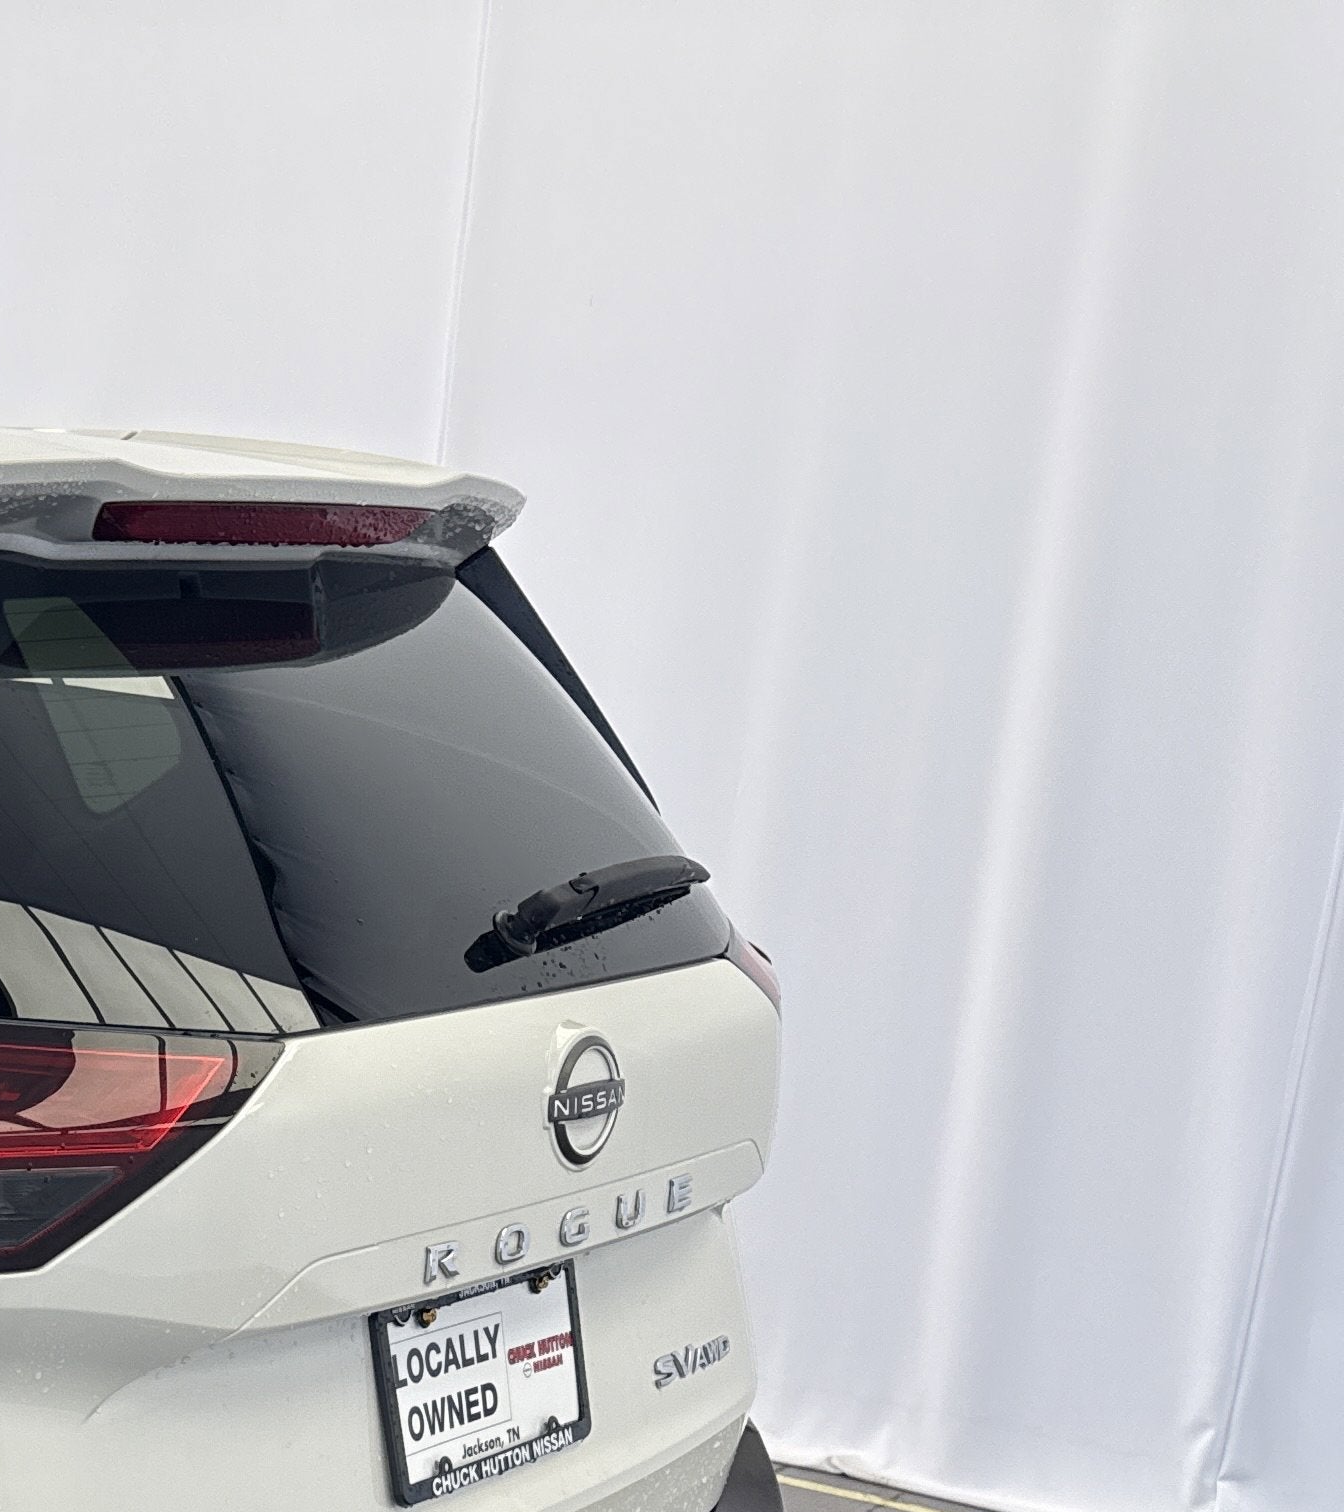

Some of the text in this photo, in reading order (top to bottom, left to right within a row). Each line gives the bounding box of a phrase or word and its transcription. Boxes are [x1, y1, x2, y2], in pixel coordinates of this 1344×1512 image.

[553, 1085, 625, 1118] NISSAN
[425, 1174, 693, 1284] ROGUE
[392, 1323, 500, 1389] LOCALLY
[407, 1382, 498, 1442] OWNED
[462, 1426, 521, 1459] Jackson, TN
[432, 1427, 573, 1496] CHUCK HUTTON NISSAN
